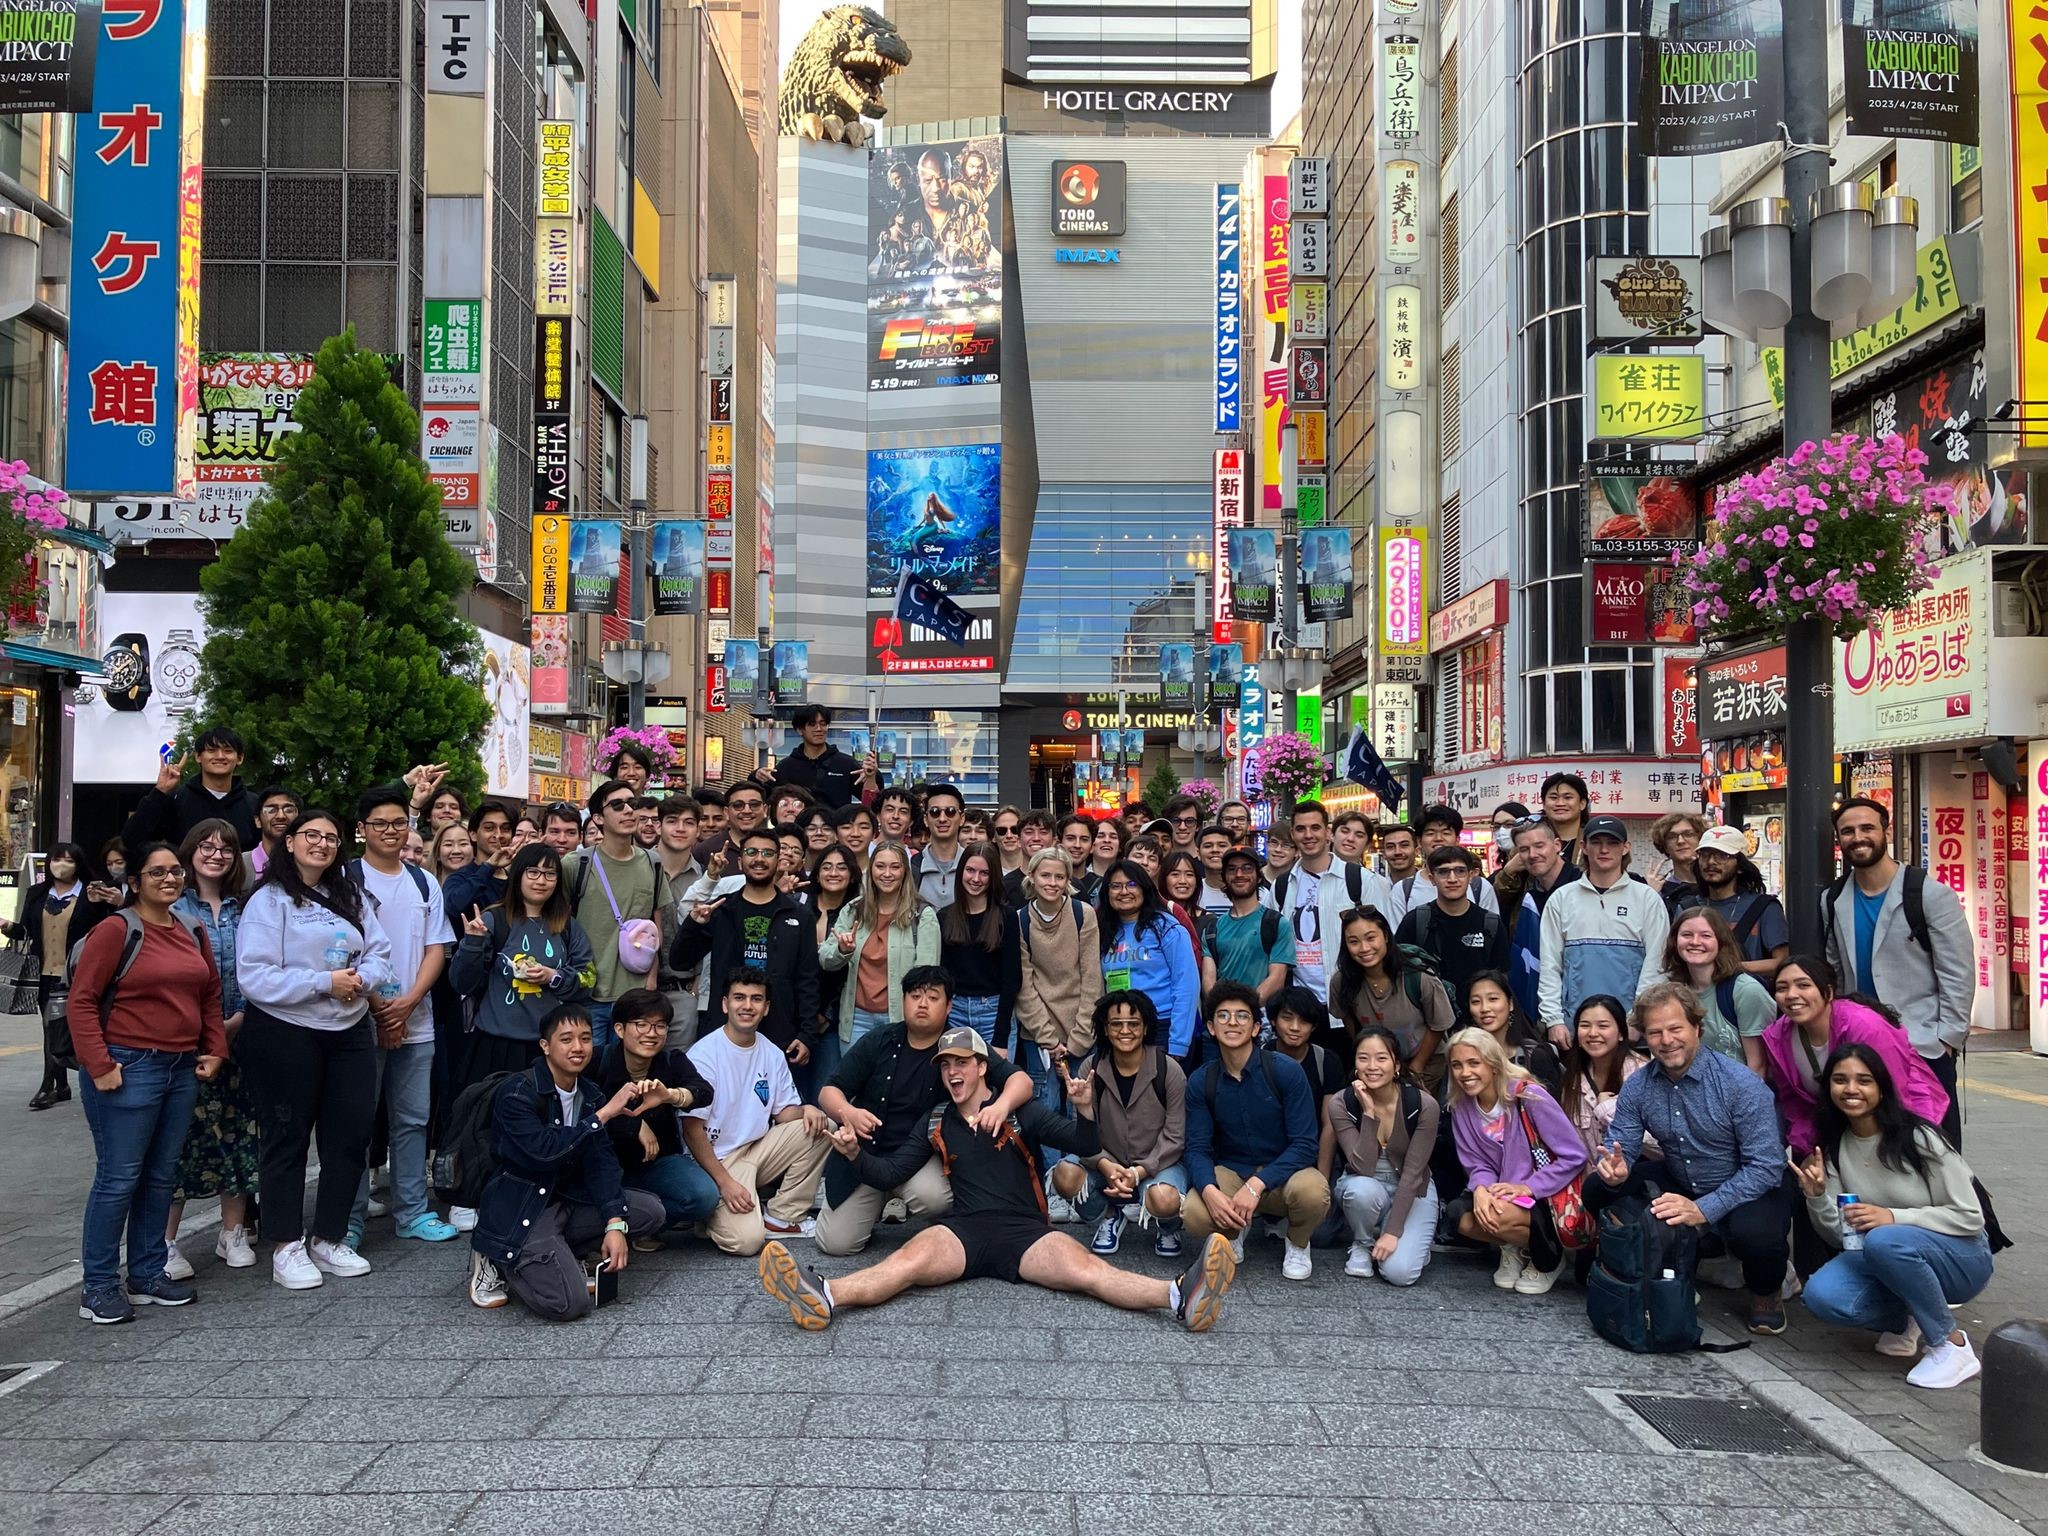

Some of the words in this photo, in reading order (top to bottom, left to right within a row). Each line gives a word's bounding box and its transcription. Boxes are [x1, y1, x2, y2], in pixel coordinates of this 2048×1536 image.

[1393, 36, 1411, 44] 5F
[1661, 37, 1758, 56] EVANGELION
[1866, 29, 1960, 46] EVANGELION
[442, 15, 471, 80] TFC
[1866, 41, 1960, 74] KABUKICHO
[1660, 50, 1758, 87] KABUKICHO
[1867, 69, 1961, 93] IMPACT
[1044, 90, 1120, 111] HOTEL
[1124, 90, 1232, 112] GRACERY
[1660, 79, 1759, 105] IMPACT
[1393, 141, 1411, 150] 5F
[1059, 209, 1095, 221] TOHO
[1059, 221, 1109, 232] CINEMAS
[547, 228, 568, 304] CAPSULE
[1394, 266, 1412, 275] 6F
[1619, 291, 1684, 312] HAPPY
[428, 324, 443, 370] カフェ
[447, 304, 471, 371] 爬虫類
[879, 317, 977, 360] FIRE
[1219, 269, 1240, 422] カラオケランド
[921, 339, 994, 357] BOOST
[936, 375, 971, 385] IMAX
[1619, 363, 1681, 392] 雀荘
[546, 401, 560, 410] 3F
[1394, 392, 1413, 401] 7F
[538, 425, 547, 445] BAR
[429, 446, 473, 456] EXCHANGE
[549, 422, 567, 499] AGEHA
[538, 455, 547, 474] PUB
[545, 501, 559, 511] 2F
[710, 482, 730, 514] 麻雀
[1651, 567, 1674, 584] 1F
[574, 588, 610, 597] IMPACT
[659, 589, 692, 598] IMPACT
[1595, 580, 1644, 596] MAO
[909, 583, 967, 627] CIS
[1601, 596, 1637, 606] ANNEX
[905, 609, 959, 641] JAPAN
[1610, 630, 1629, 639] B1F
[1386, 668, 1422, 681] 東京ビル
[1707, 660, 1759, 685] 海の幸いろいろ
[1935, 806, 1966, 910] 夜の相
[744, 951, 768, 959] FUTUR
